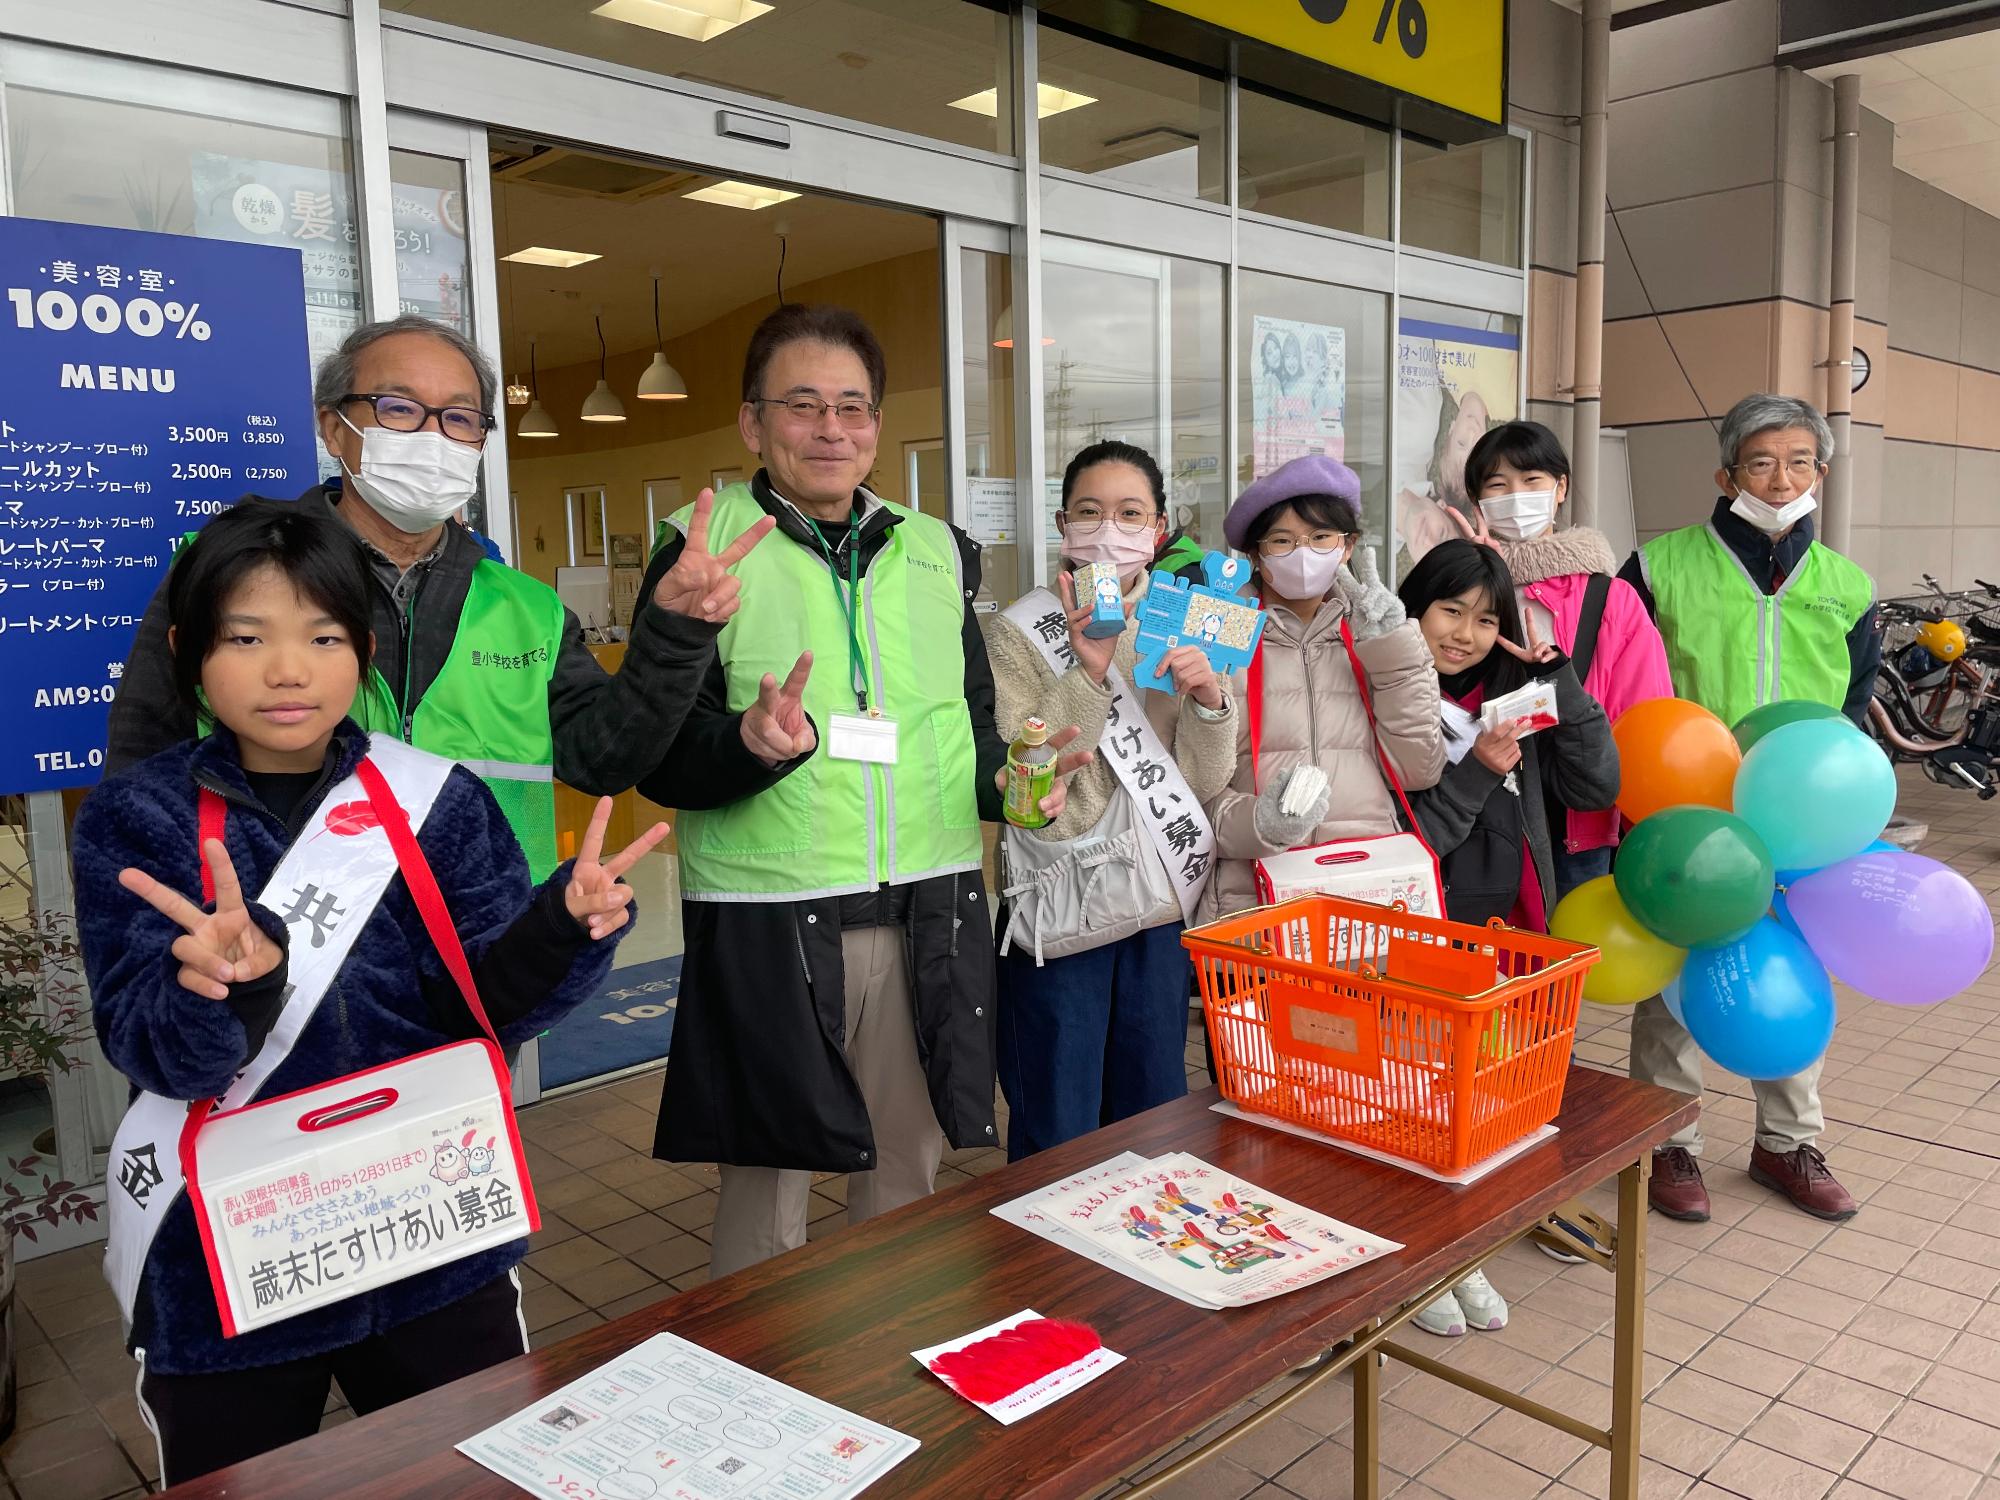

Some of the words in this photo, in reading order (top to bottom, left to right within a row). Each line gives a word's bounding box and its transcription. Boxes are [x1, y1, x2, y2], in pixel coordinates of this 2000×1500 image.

[240, 198, 276, 215] 乾燥
[291, 189, 337, 243] 髪
[251, 215, 268, 225] から
[8, 288, 212, 342] 1000%
[60, 363, 176, 393] MENU
[246, 415, 277, 427] (税込)
[168, 427, 229, 444] 3,500円
[242, 432, 285, 445] (3,850)
[1, 460, 100, 479] ールカット
[171, 464, 232, 480] 2,500円
[245, 467, 287, 480] (2,750)
[0, 501, 24, 516] マ
[0, 537, 106, 556] レートパーマ
[42, 578, 105, 592] (ブロー付)
[108, 662, 125, 679] 営
[34, 684, 116, 709] AM9:0
[115, 1140, 165, 1212] 金
[223, 1172, 310, 1213] 赤い羽根共同募金
[252, 1184, 378, 1239] みんなでささえあう
[290, 1183, 432, 1244] あったかい地域づくり
[248, 1177, 517, 1310] 歳末たすけあい募金
